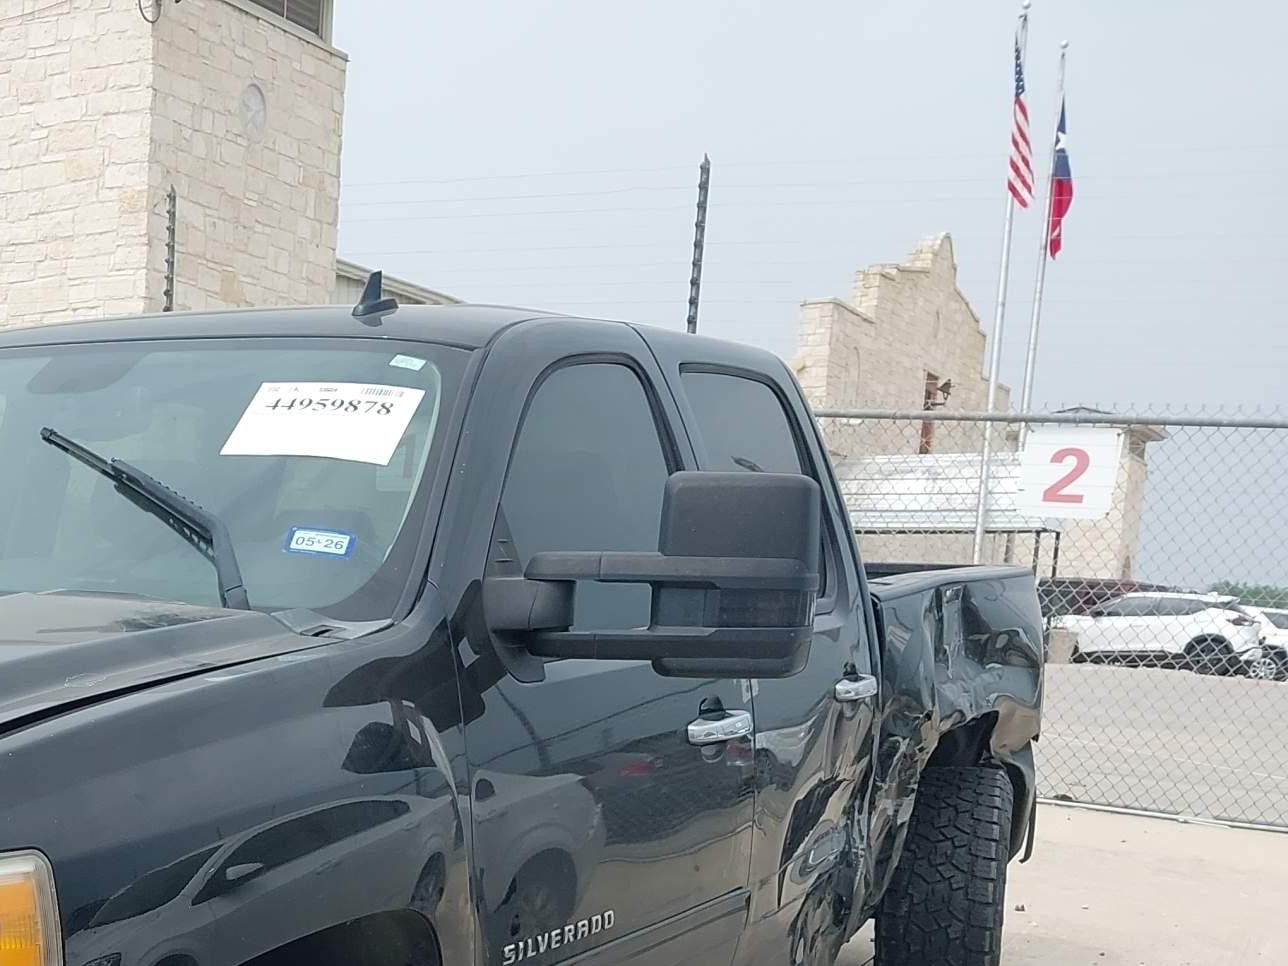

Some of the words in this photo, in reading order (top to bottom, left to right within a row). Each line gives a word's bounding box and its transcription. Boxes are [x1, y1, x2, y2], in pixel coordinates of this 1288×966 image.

[265, 397, 395, 416] 44959878
[1041, 447, 1091, 504] 2
[502, 909, 615, 966] SILVERADO
